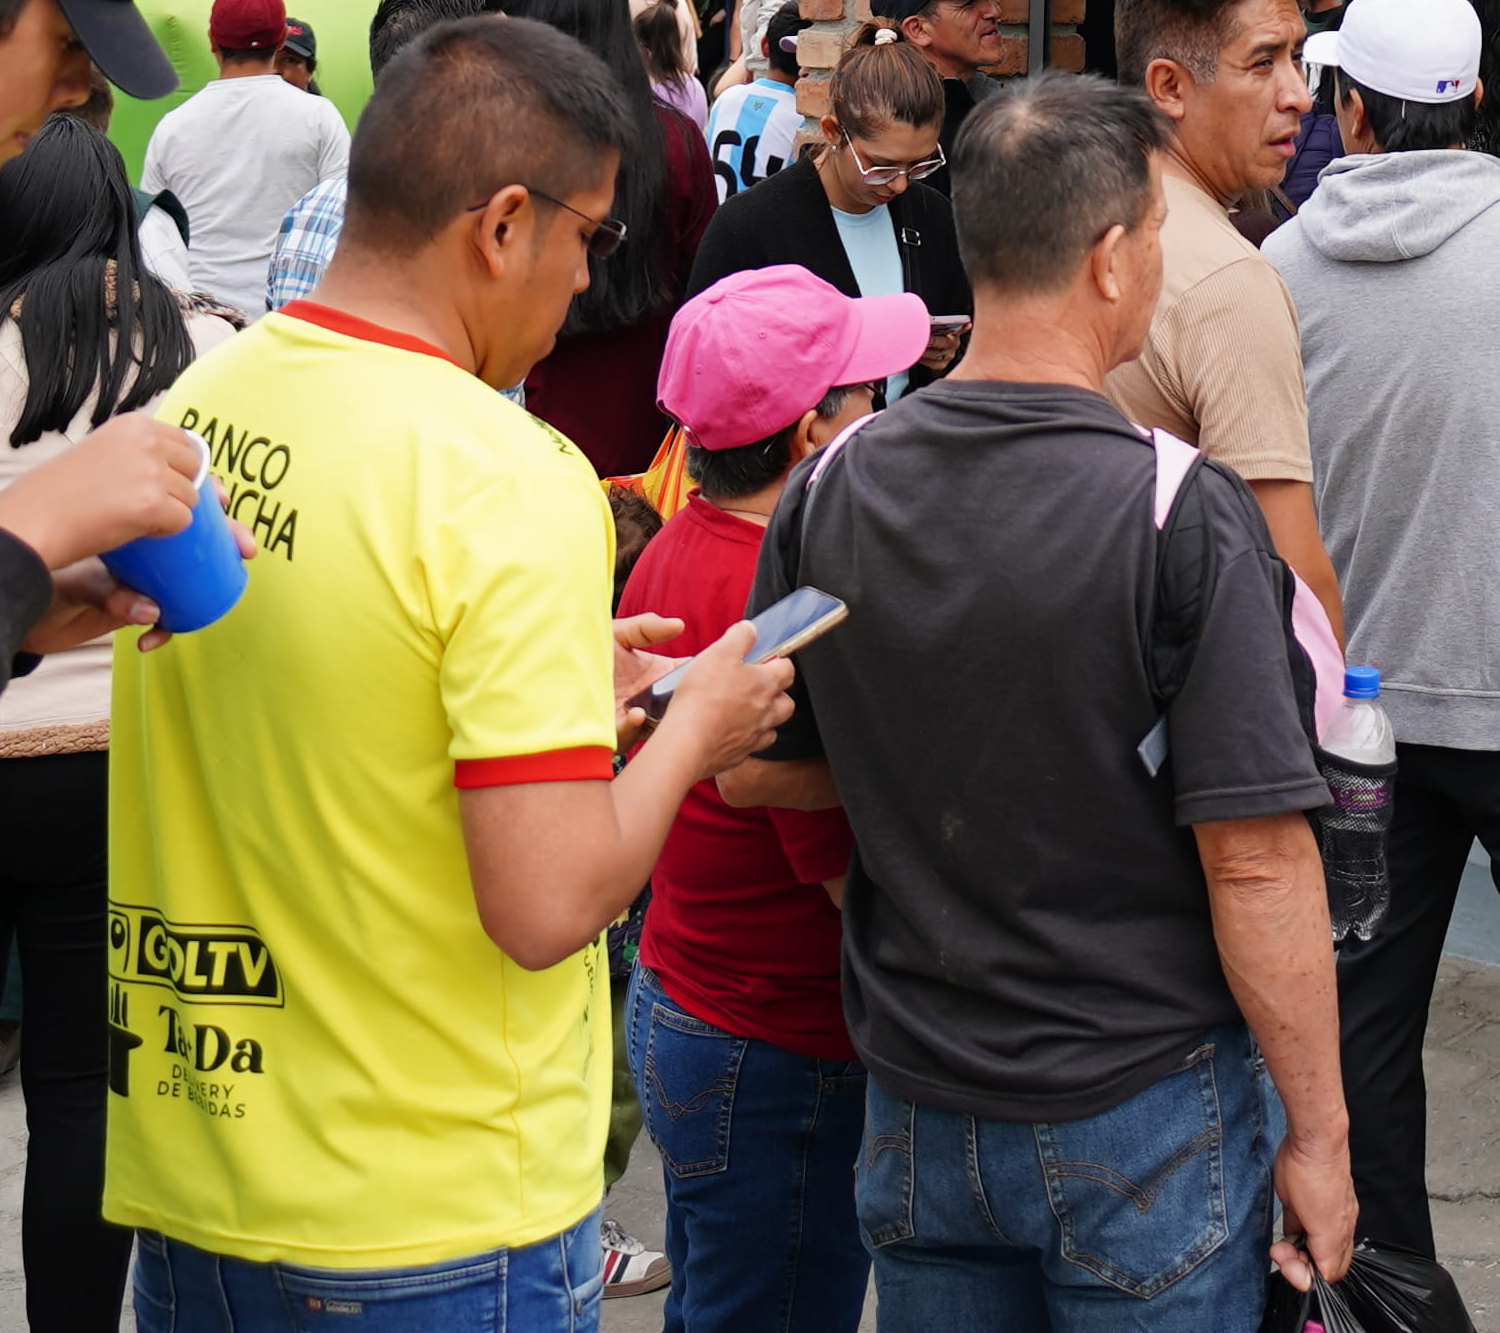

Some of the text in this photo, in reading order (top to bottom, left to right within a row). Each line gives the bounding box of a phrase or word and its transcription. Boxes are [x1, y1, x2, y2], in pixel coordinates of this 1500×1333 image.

[145, 924, 268, 988] GOLTV
[157, 1081, 246, 1119] DE BIDAS
[172, 1064, 236, 1100] DELVERY
